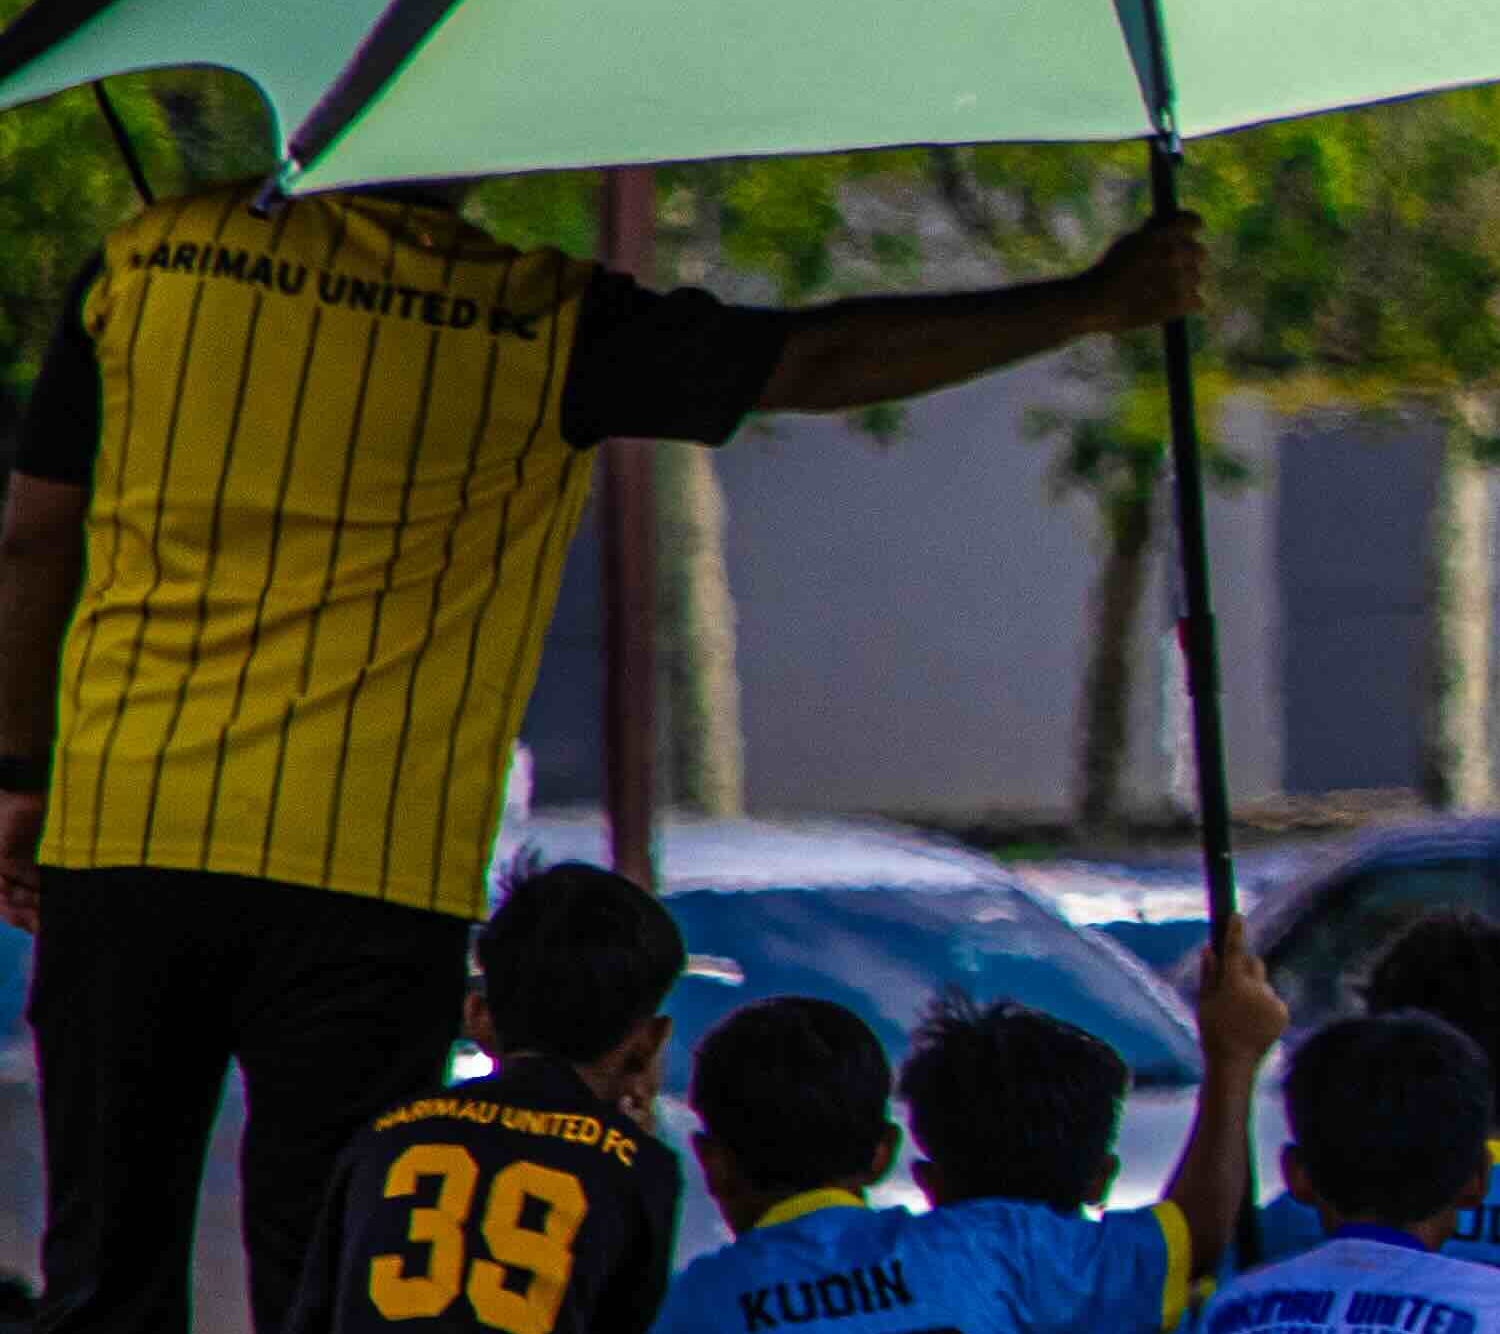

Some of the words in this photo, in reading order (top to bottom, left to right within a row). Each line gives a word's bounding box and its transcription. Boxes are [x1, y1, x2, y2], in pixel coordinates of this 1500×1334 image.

[317, 272, 478, 330] UNITED
[500, 1106, 601, 1147] UNITED
[602, 1128, 638, 1167] FC
[740, 1259, 914, 1334] KUDIN
